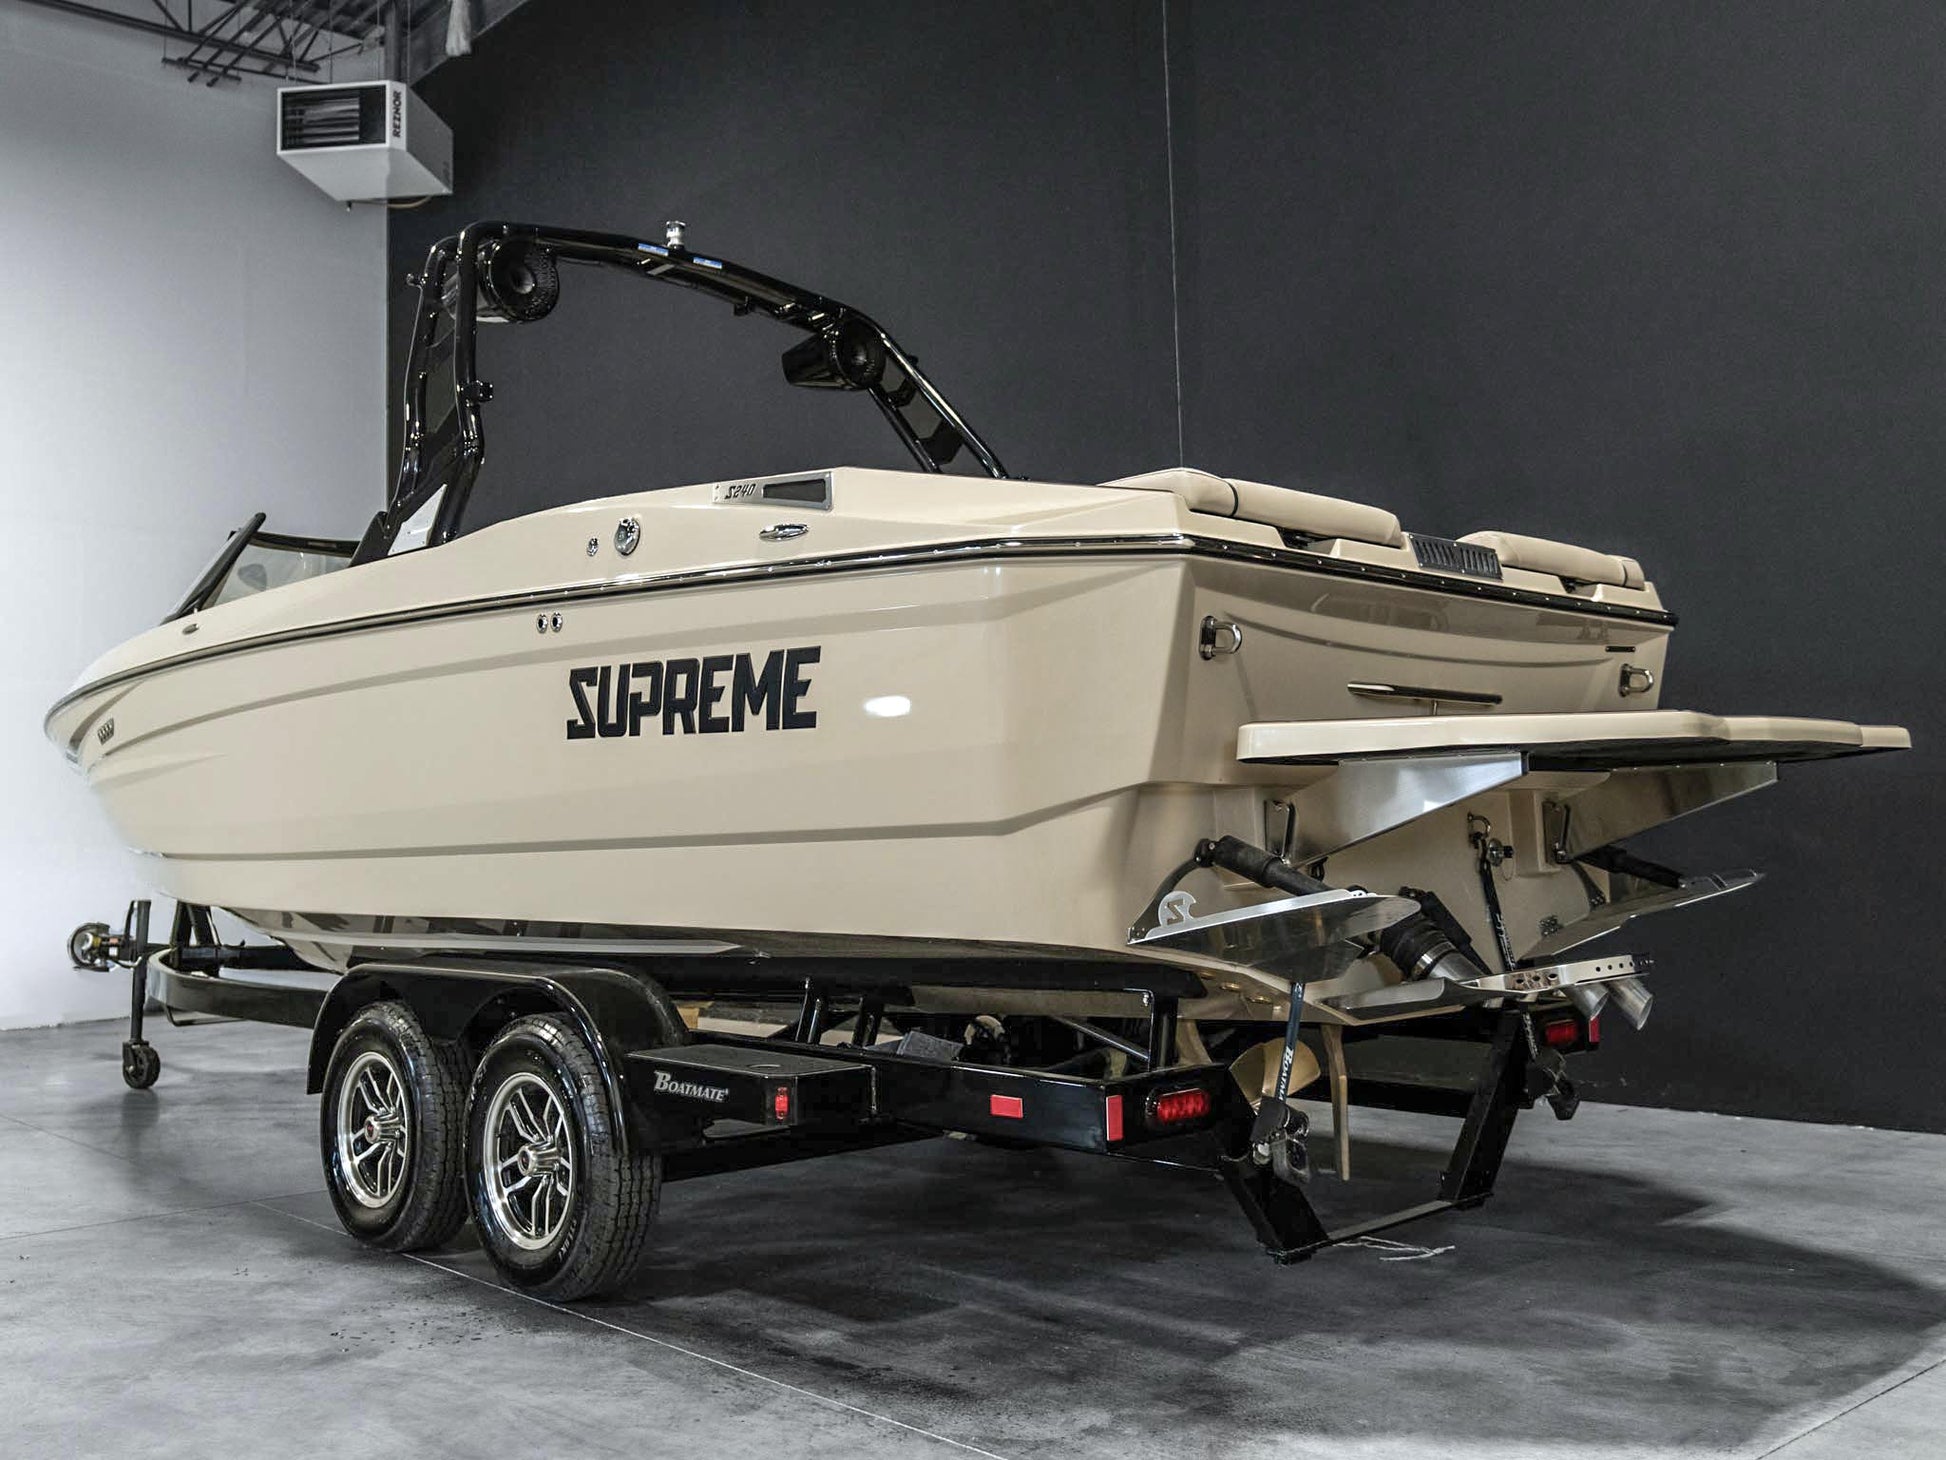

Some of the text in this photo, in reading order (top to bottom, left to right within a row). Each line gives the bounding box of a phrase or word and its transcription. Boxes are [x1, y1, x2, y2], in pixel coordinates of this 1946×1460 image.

[392, 90, 402, 138] REZNOR
[724, 483, 757, 500] S240
[566, 645, 822, 740] SUPREME
[653, 1069, 726, 1102] BOATMATE
